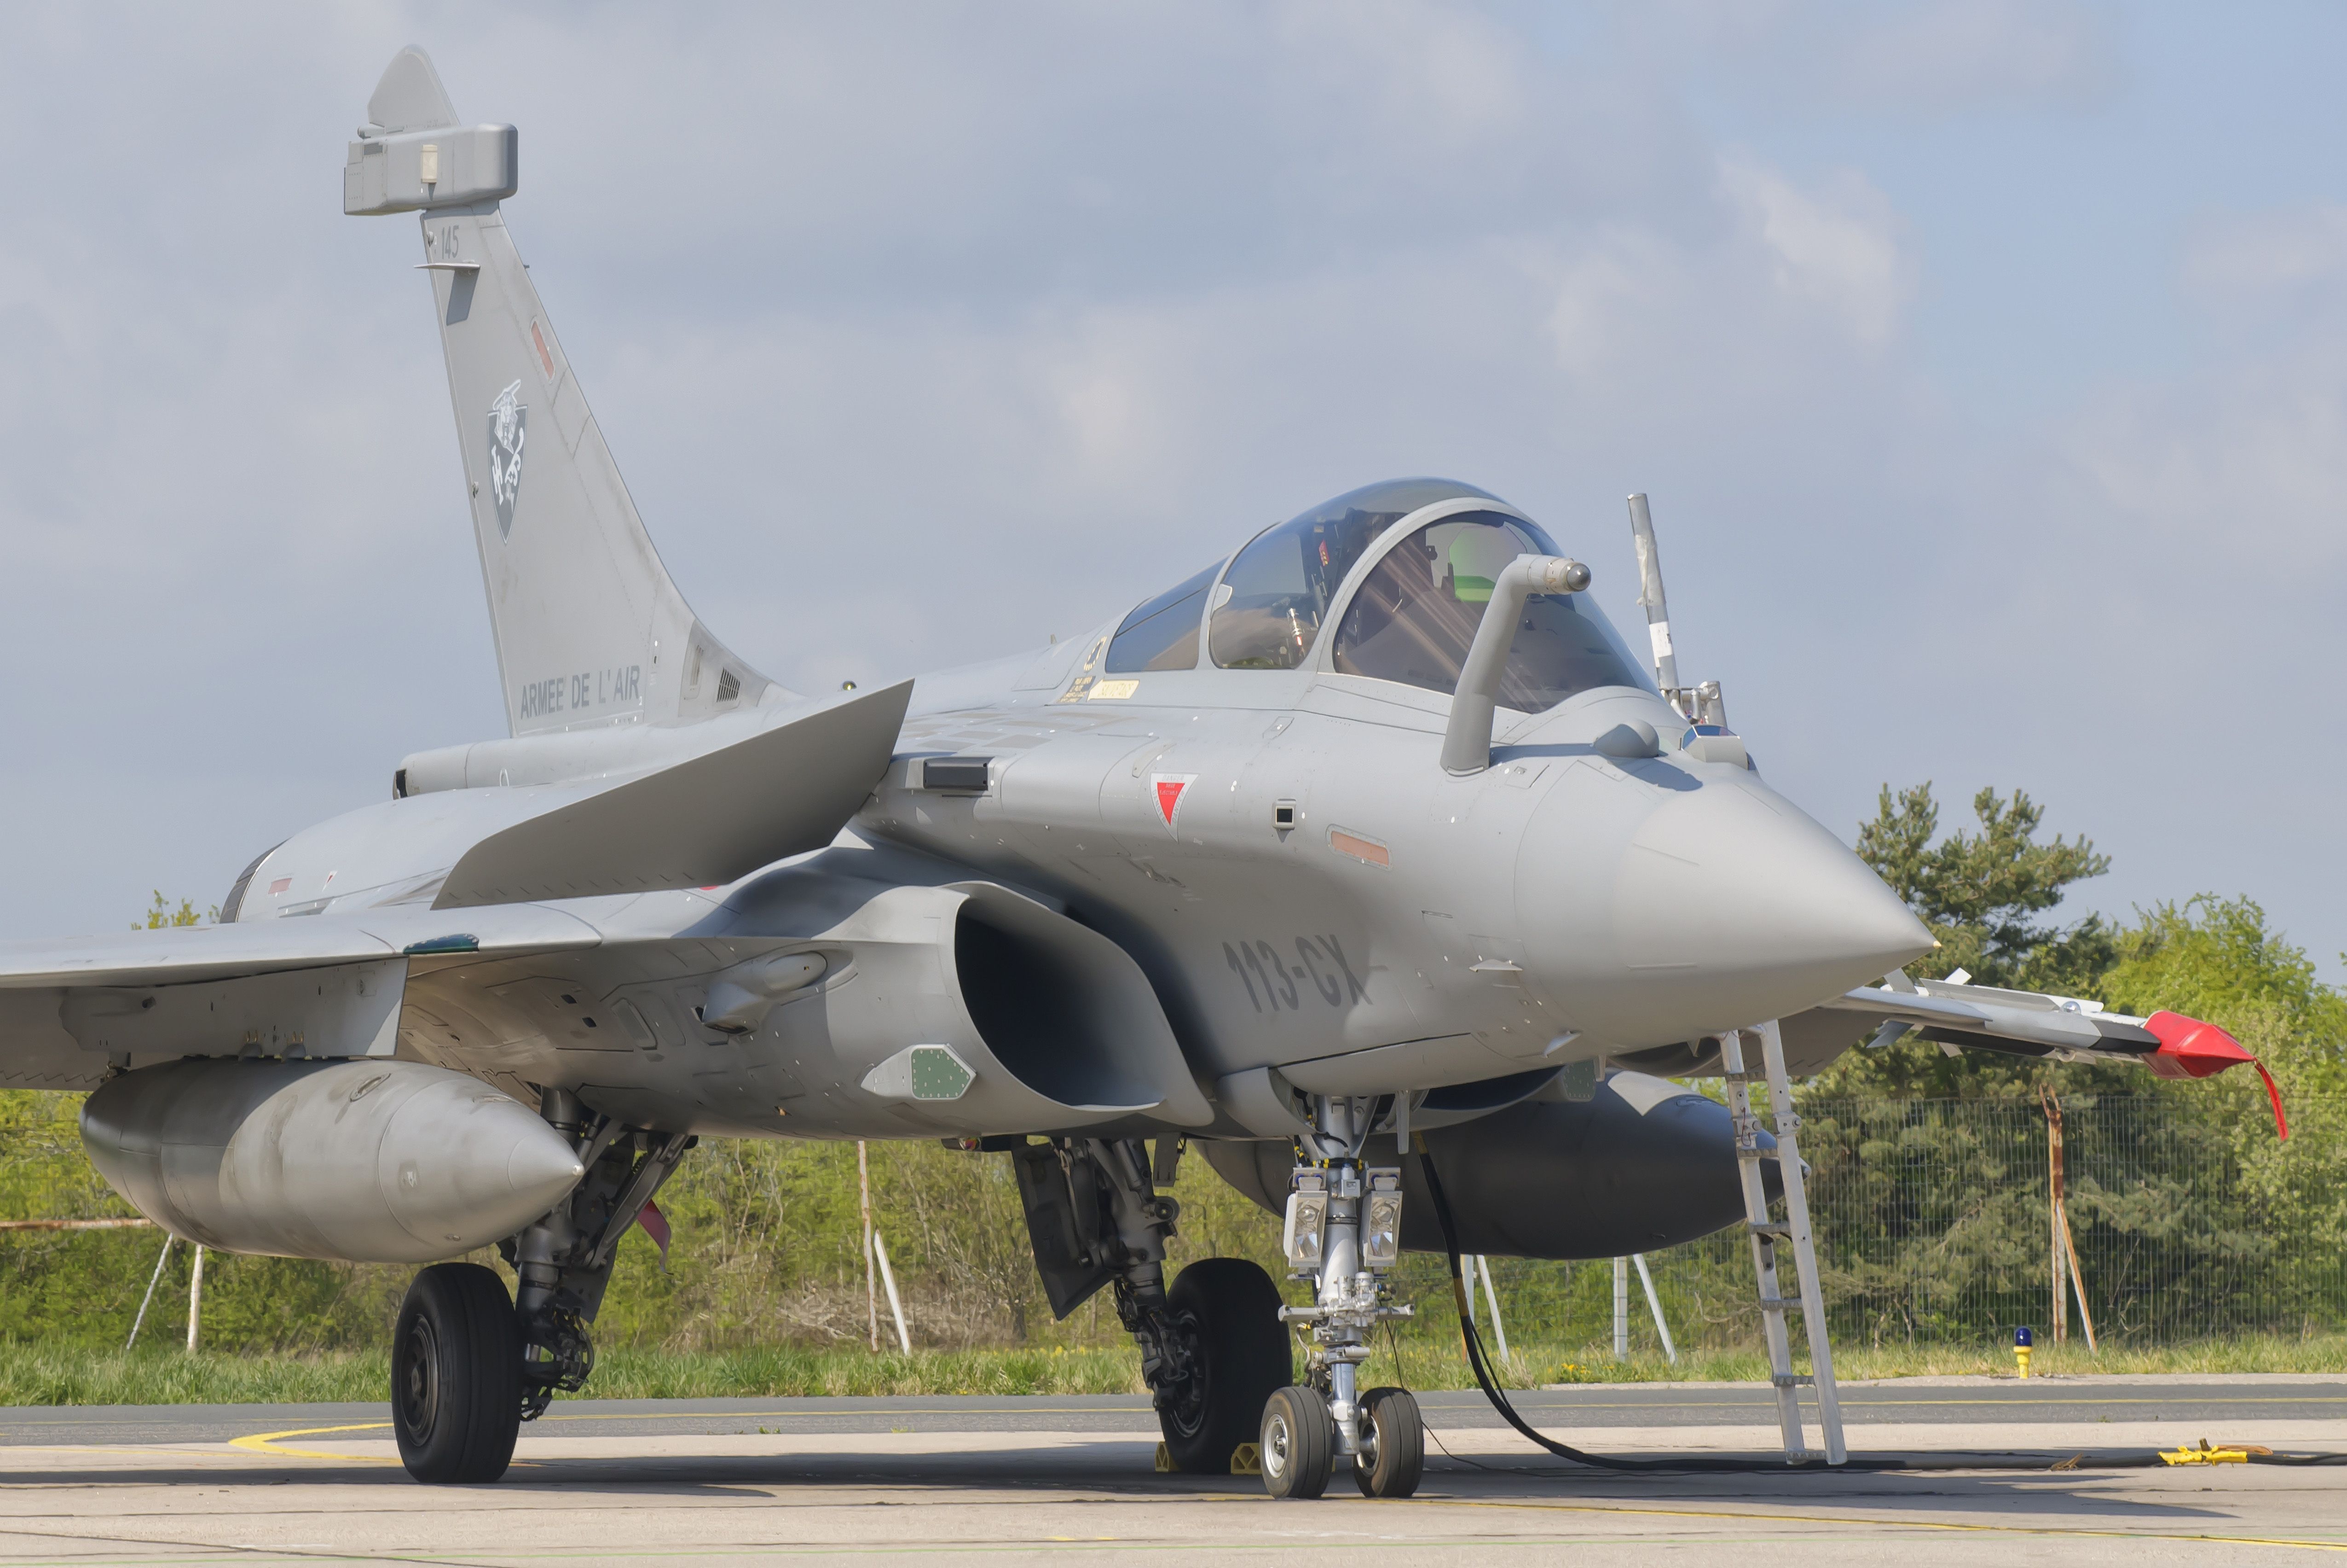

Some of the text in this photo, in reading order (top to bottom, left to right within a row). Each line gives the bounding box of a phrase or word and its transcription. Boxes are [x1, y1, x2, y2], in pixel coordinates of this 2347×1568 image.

[442, 225, 459, 259] 145
[520, 677, 564, 720] ARMEE
[572, 673, 590, 709] DE
[1222, 934, 1373, 1013] 113-CX
